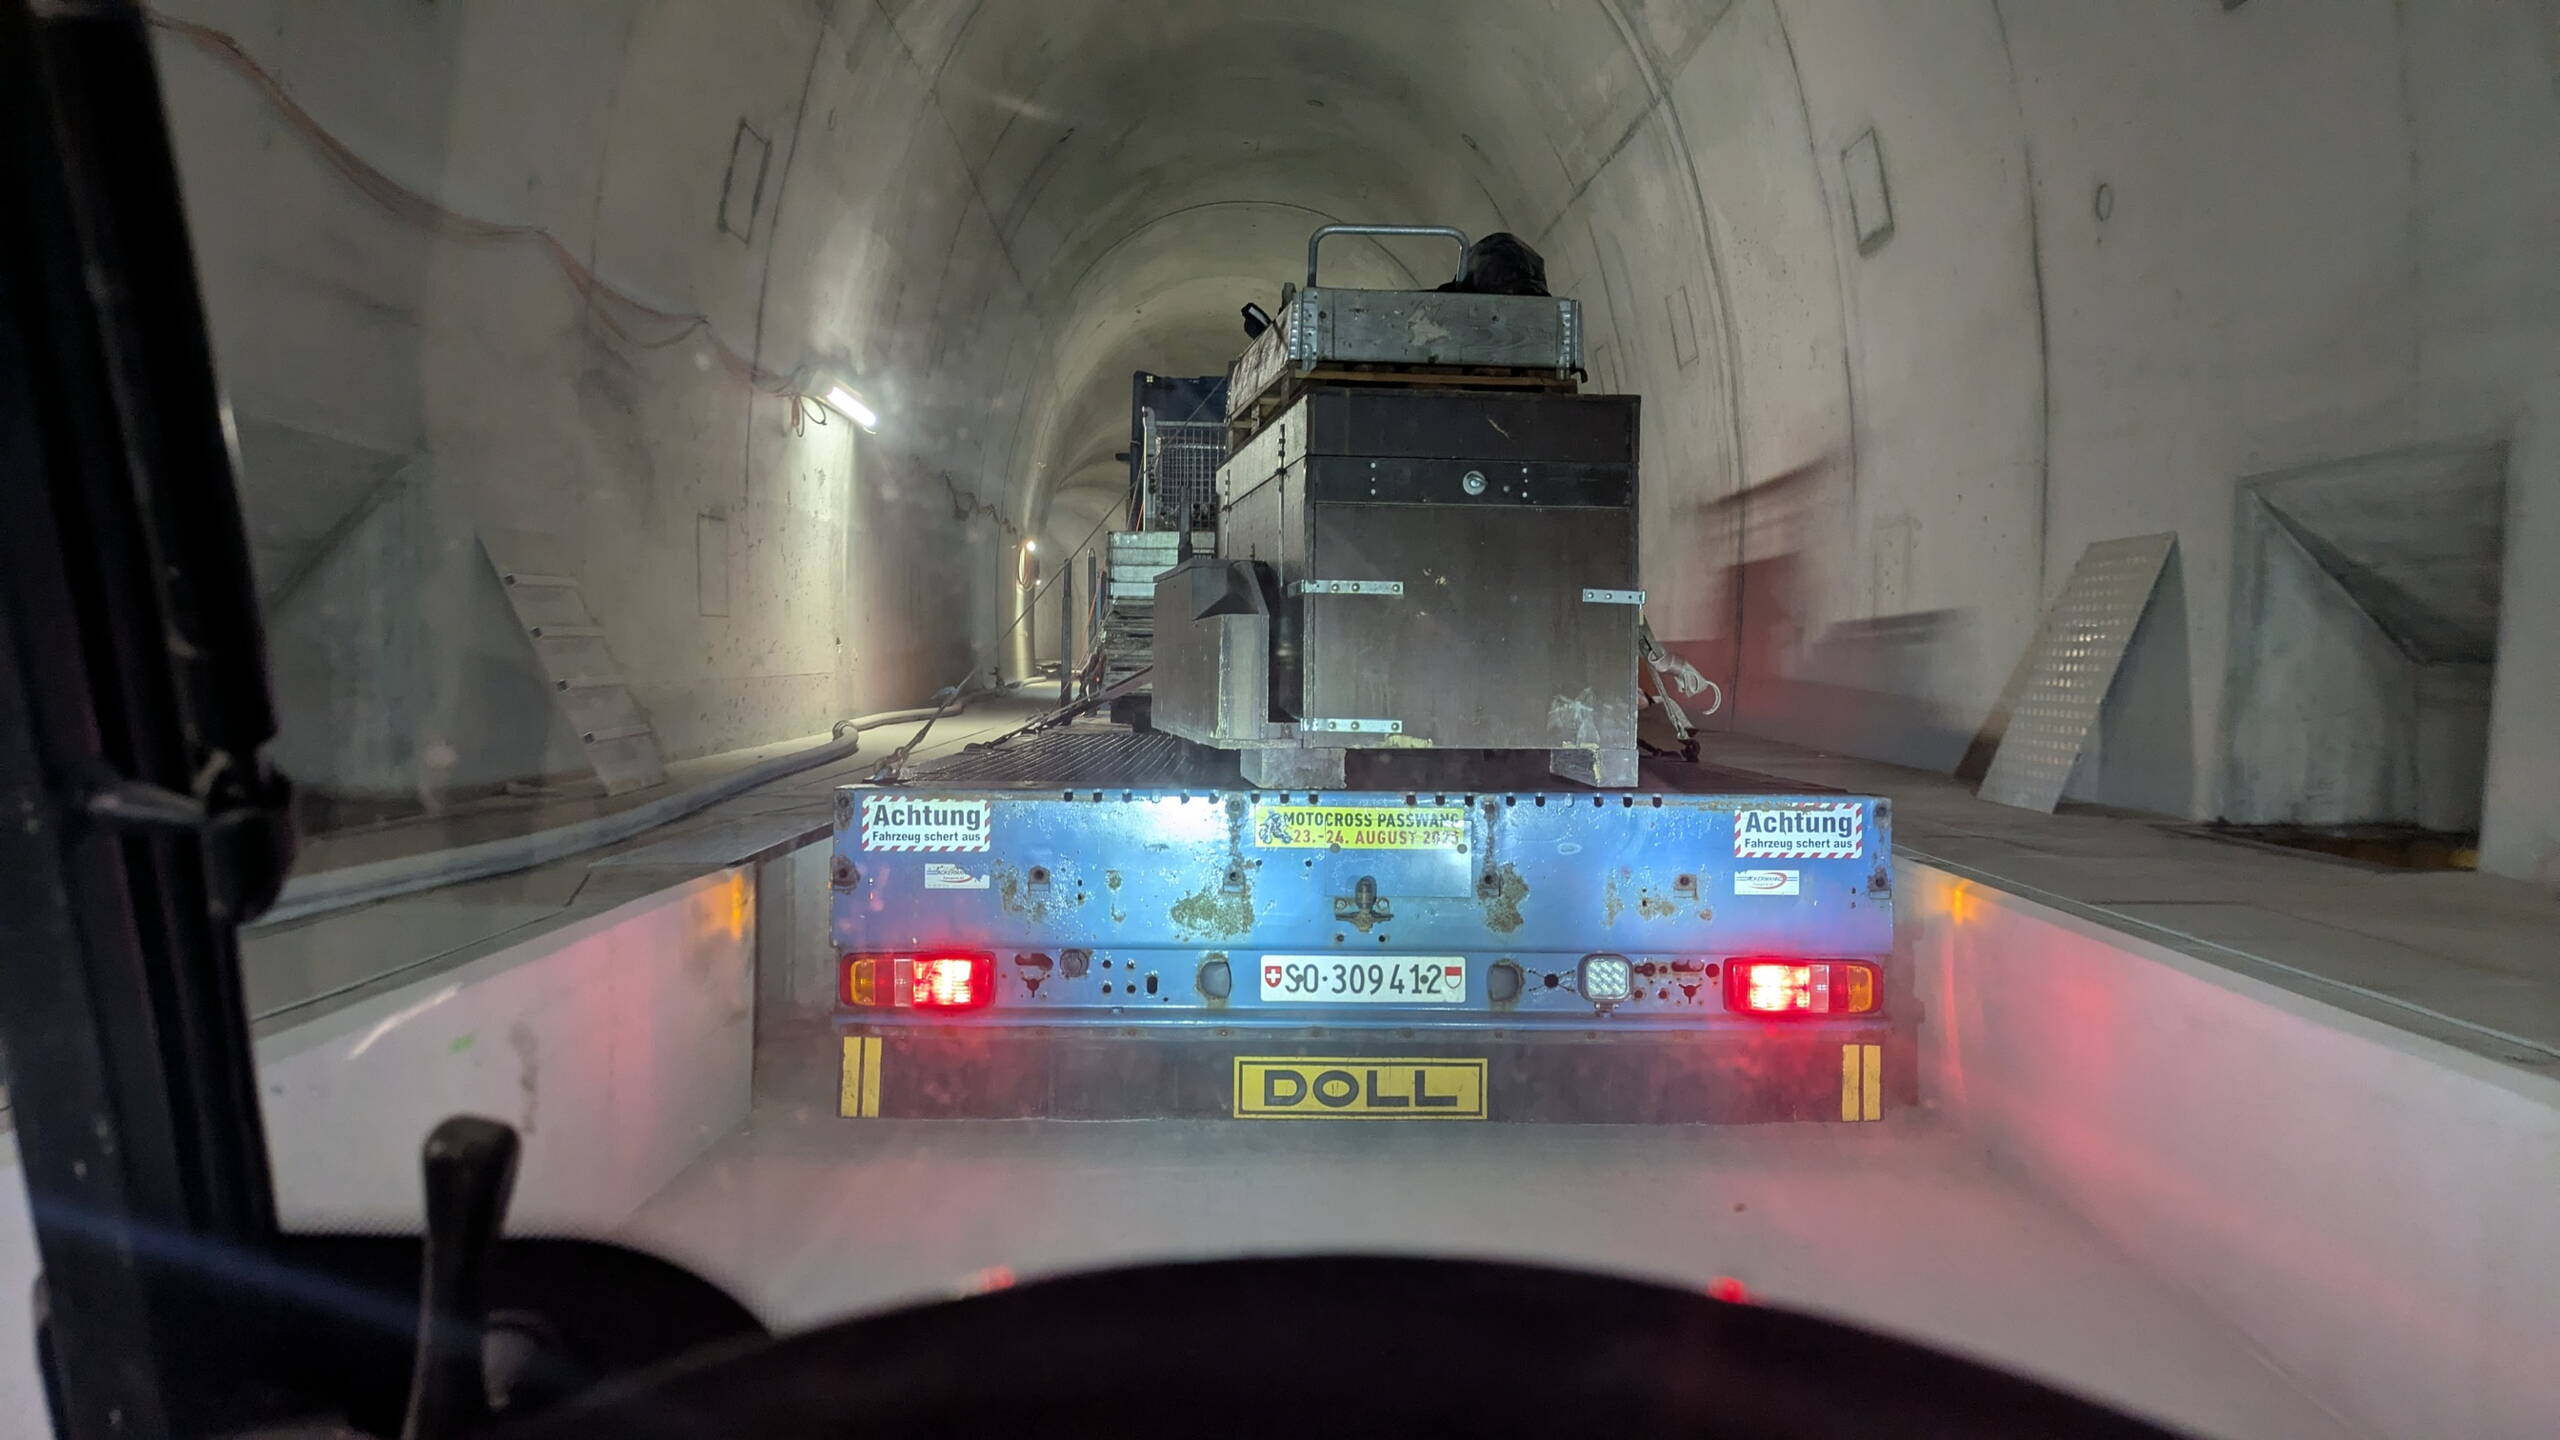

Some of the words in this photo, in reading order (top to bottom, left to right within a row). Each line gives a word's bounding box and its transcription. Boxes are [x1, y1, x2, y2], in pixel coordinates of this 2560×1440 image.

[872, 804, 981, 831] Achtung
[1284, 812, 1373, 827] MOTOCROSS
[1745, 812, 1853, 838] Achtung
[872, 831, 921, 843] Fahrzeug
[925, 831, 958, 841] schert
[962, 833, 981, 841] aus
[1355, 830, 1416, 844] AUGUST
[1745, 838, 1793, 850] Fahrzeug
[1796, 838, 1830, 848] schert
[1834, 840, 1853, 848] aus
[1264, 1069, 1458, 1107] DOLL
